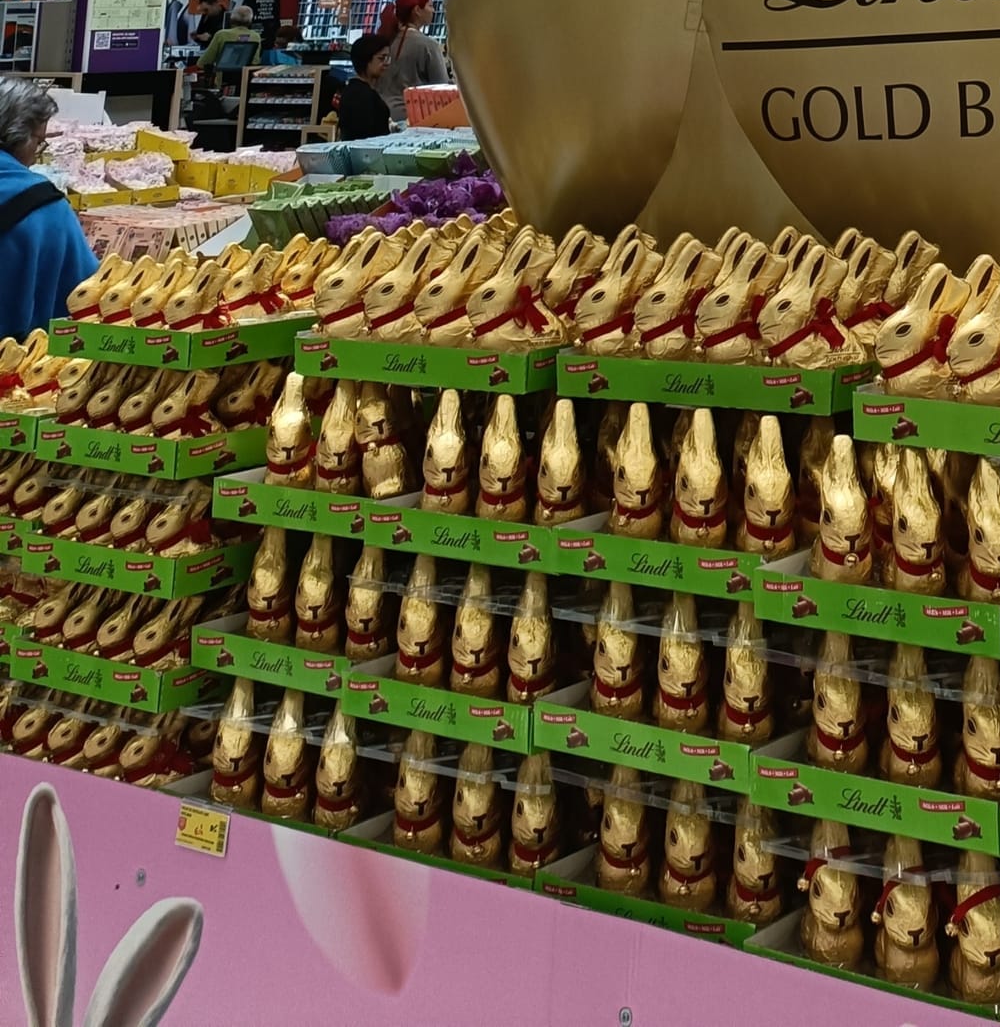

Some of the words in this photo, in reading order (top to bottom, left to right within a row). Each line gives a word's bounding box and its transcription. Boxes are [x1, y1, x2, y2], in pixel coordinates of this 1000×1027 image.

[761, 83, 931, 142] GOLD
[98, 334, 128, 354] Lindt
[383, 353, 418, 373] Lindt
[662, 373, 703, 395] Lindt
[272, 498, 310, 520] Lindt
[430, 526, 472, 549] Lindt
[627, 552, 673, 577] Lindt
[841, 598, 895, 626] Lindt
[250, 650, 286, 674] Lindt
[406, 697, 449, 723] Lindt
[610, 732, 656, 760] Lindt
[838, 787, 891, 817] Lindt
